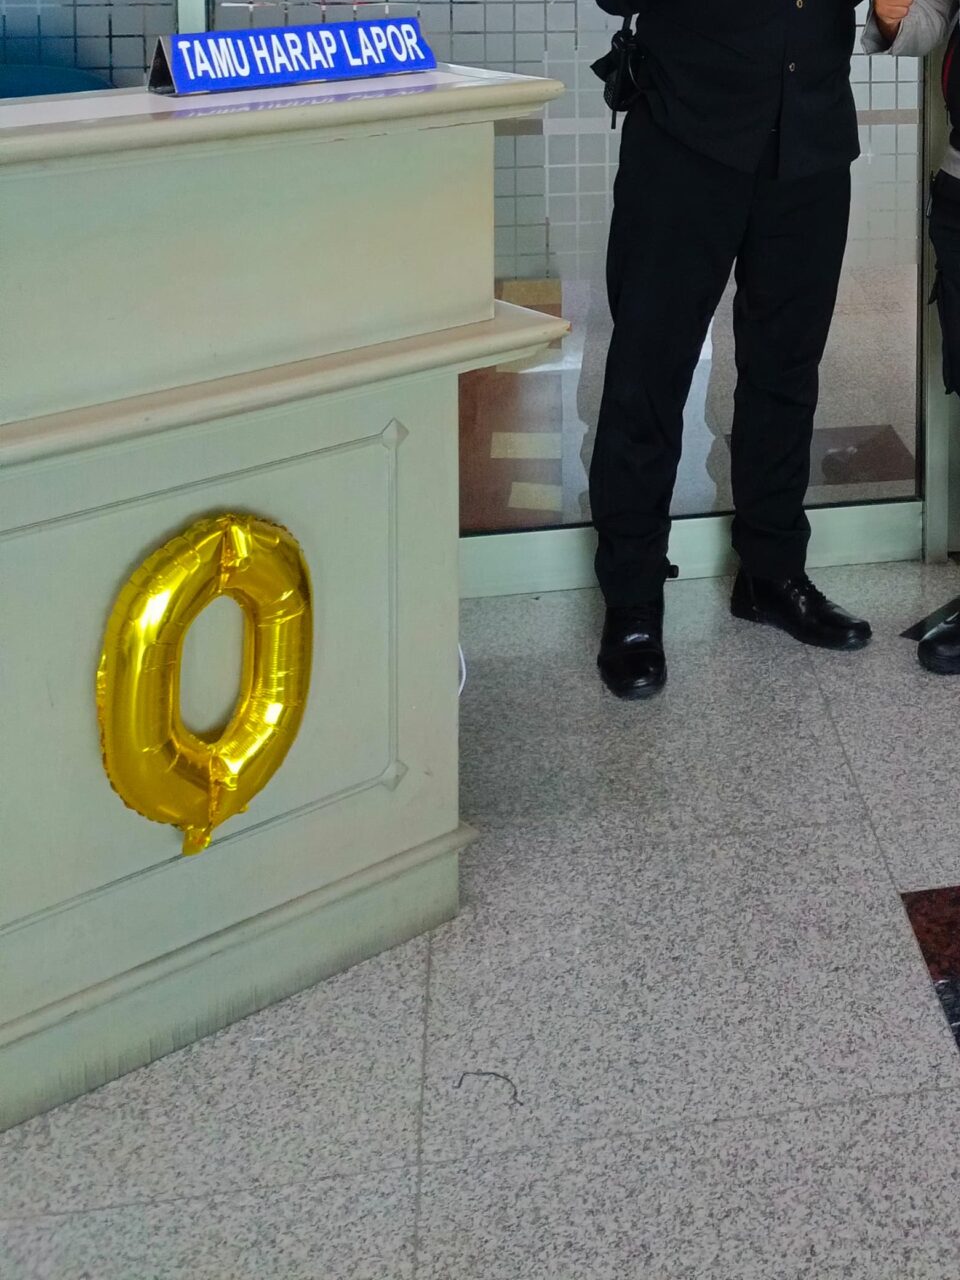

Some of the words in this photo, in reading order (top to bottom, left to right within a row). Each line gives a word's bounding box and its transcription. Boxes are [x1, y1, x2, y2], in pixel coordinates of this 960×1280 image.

[177, 36, 251, 81] TAMU
[249, 29, 338, 75] HARAP
[339, 23, 426, 67] LAPOR
